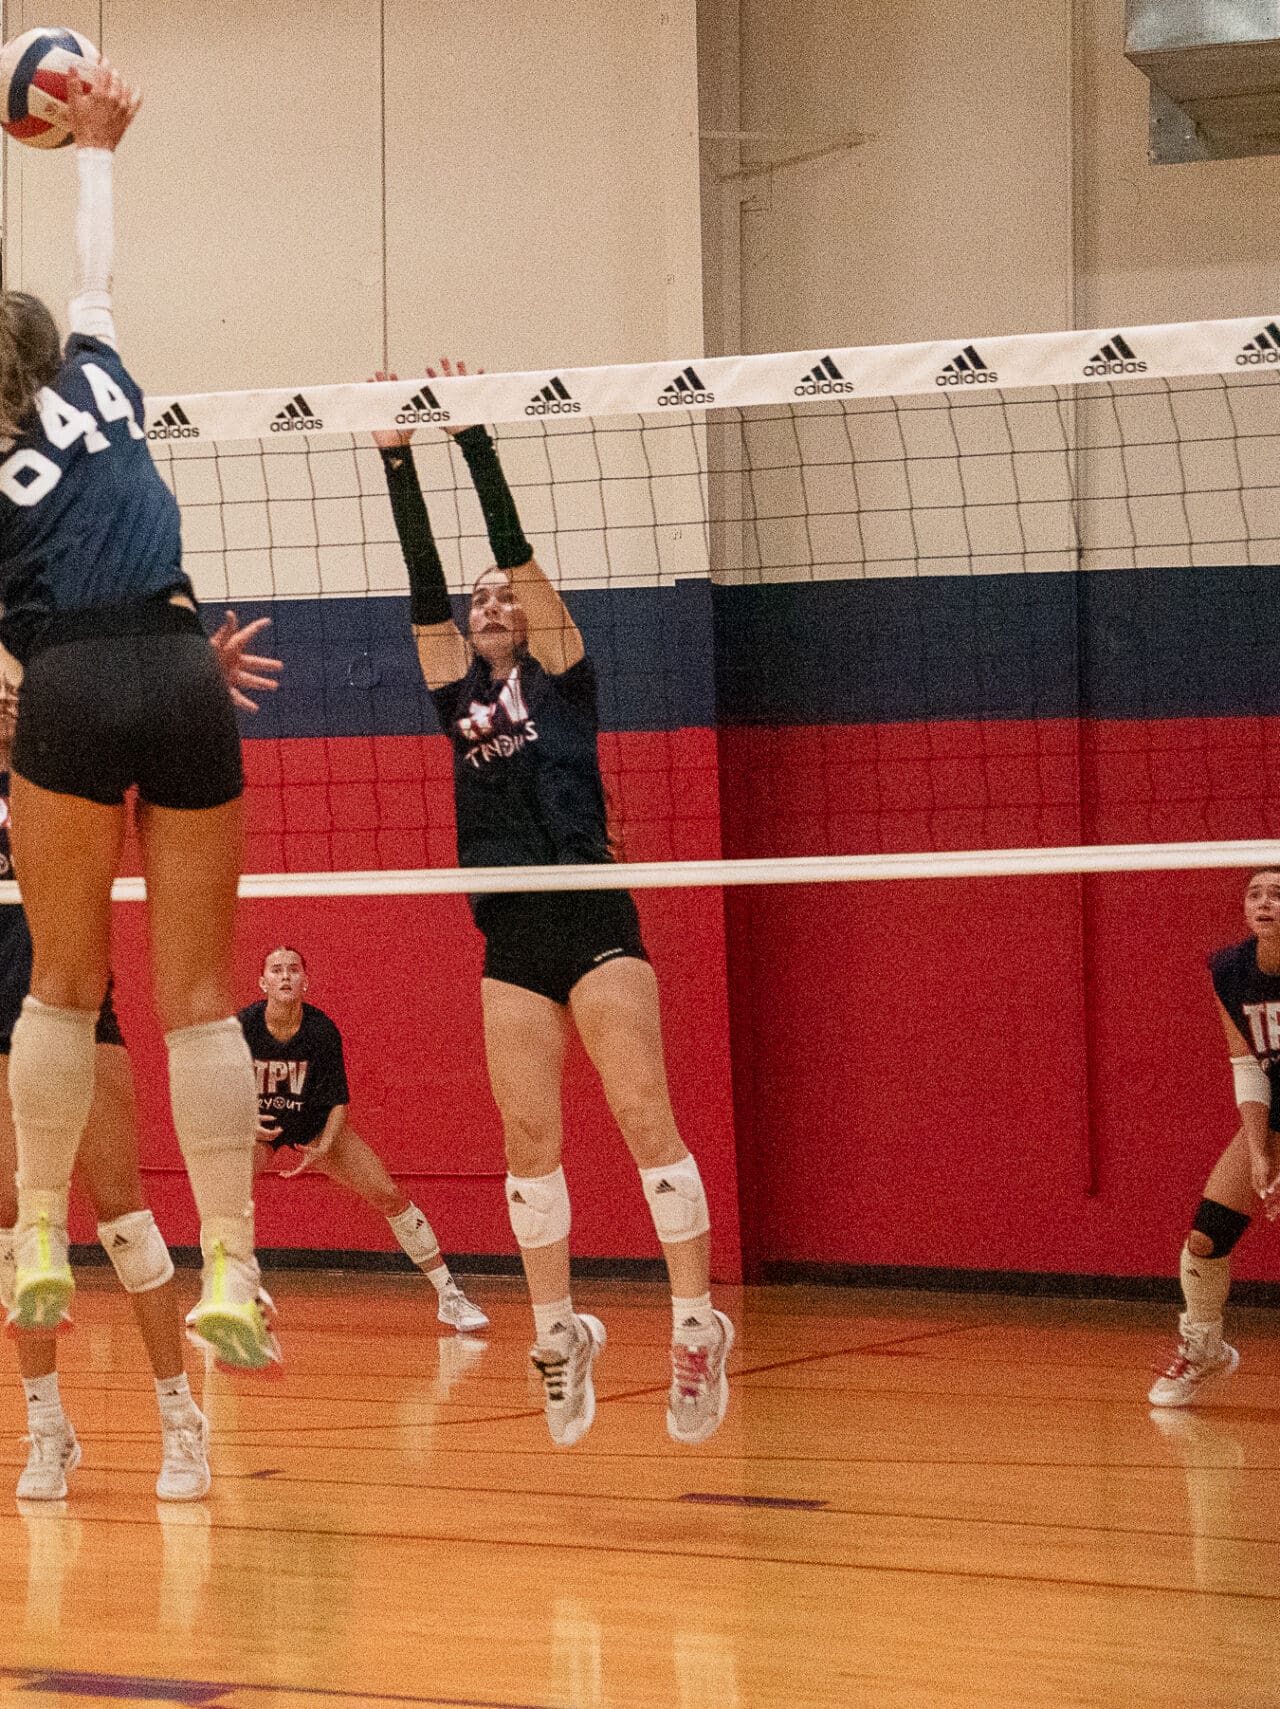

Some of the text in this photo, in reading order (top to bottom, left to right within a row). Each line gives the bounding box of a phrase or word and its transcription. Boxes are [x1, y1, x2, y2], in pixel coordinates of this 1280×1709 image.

[1236, 349, 1280, 365] adid
[1083, 360, 1147, 376] adidas
[936, 370, 998, 386] adidas
[794, 379, 854, 396] adidas
[657, 390, 715, 406] adidas
[525, 400, 581, 415] adidas
[270, 417, 323, 431] adidas
[396, 410, 450, 424] adidas
[147, 425, 200, 439] adidas
[254, 1059, 308, 1095] TPV
